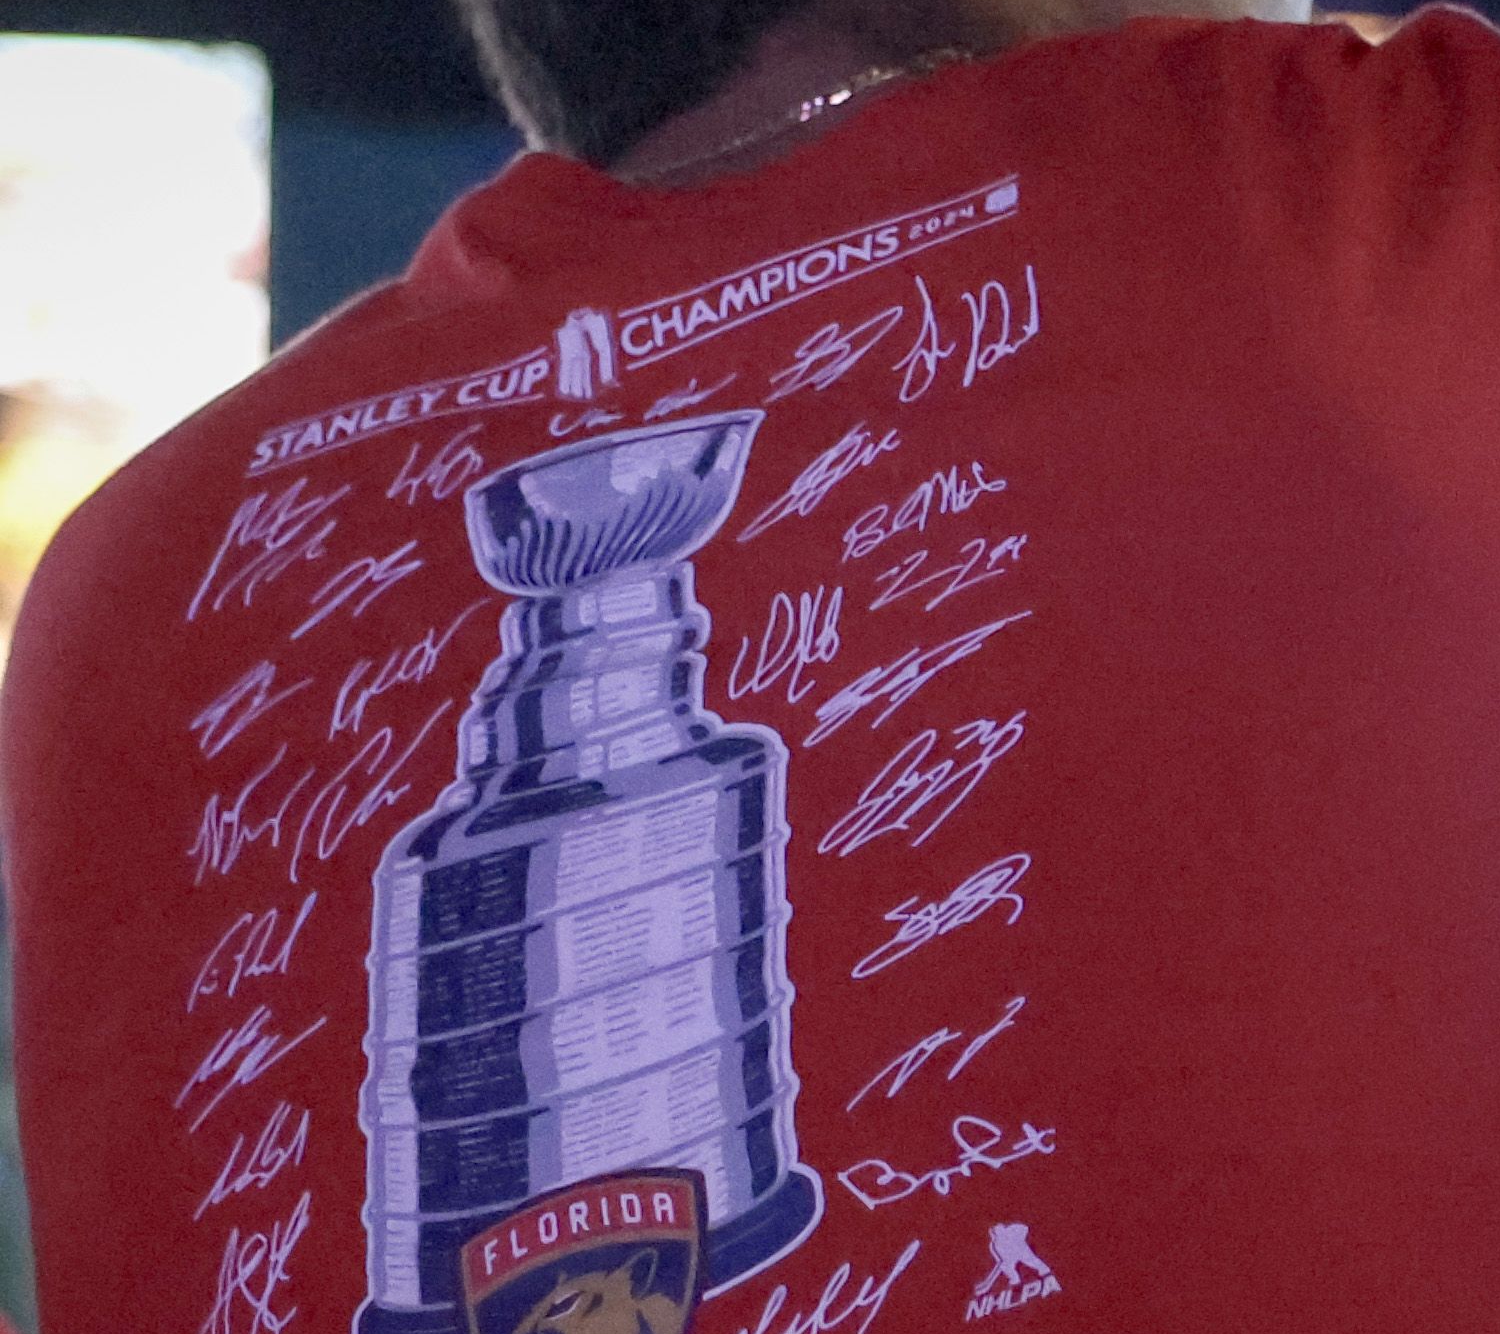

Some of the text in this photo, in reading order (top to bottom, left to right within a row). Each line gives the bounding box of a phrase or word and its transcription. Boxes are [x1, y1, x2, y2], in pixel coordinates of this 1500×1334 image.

[249, 387, 446, 471] STANLEY
[456, 357, 549, 406] CUP
[619, 225, 900, 356] CHAMPIONS
[908, 204, 975, 241] 2024
[484, 1192, 675, 1276] FLORIDA
[965, 1274, 1063, 1322] NHLPA
